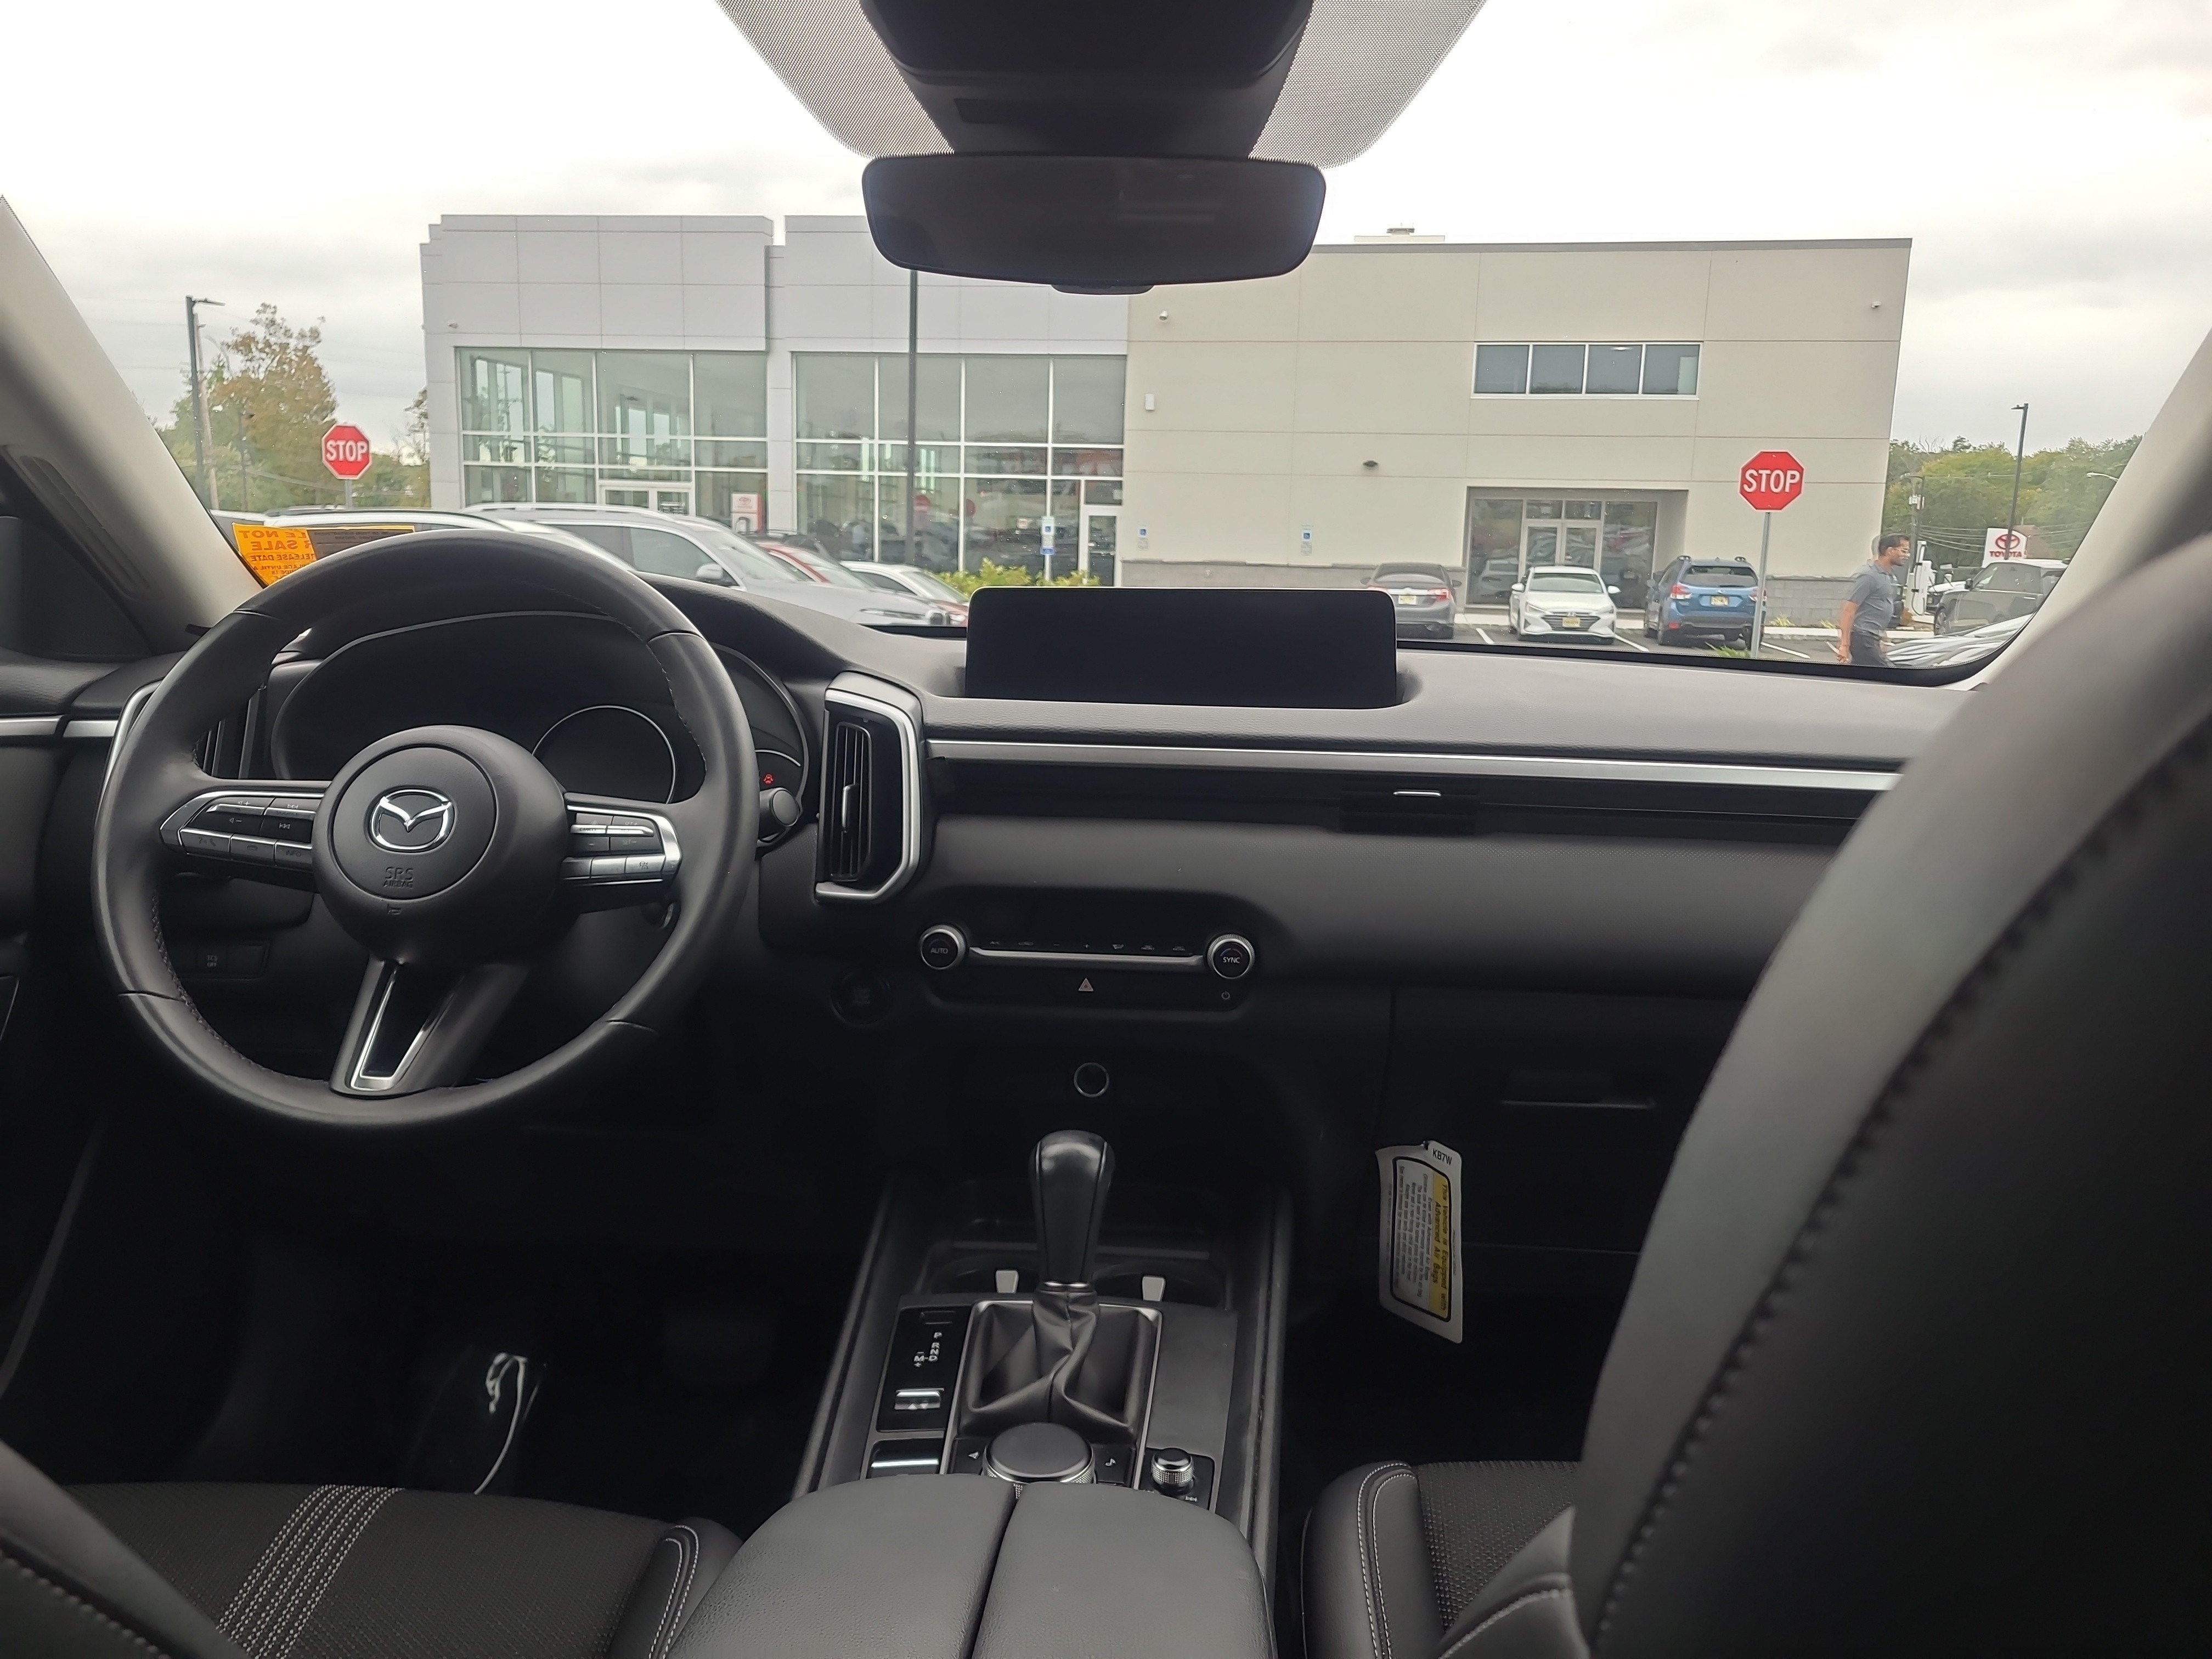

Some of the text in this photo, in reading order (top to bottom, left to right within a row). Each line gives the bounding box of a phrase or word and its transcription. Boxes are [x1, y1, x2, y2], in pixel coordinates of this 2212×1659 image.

[326, 440, 368, 462] STOP
[1743, 469, 1800, 493] STOP
[385, 867, 414, 880] SRS
[383, 880, 414, 888] AIRBAG
[1432, 1148, 1452, 1166] KB7W
